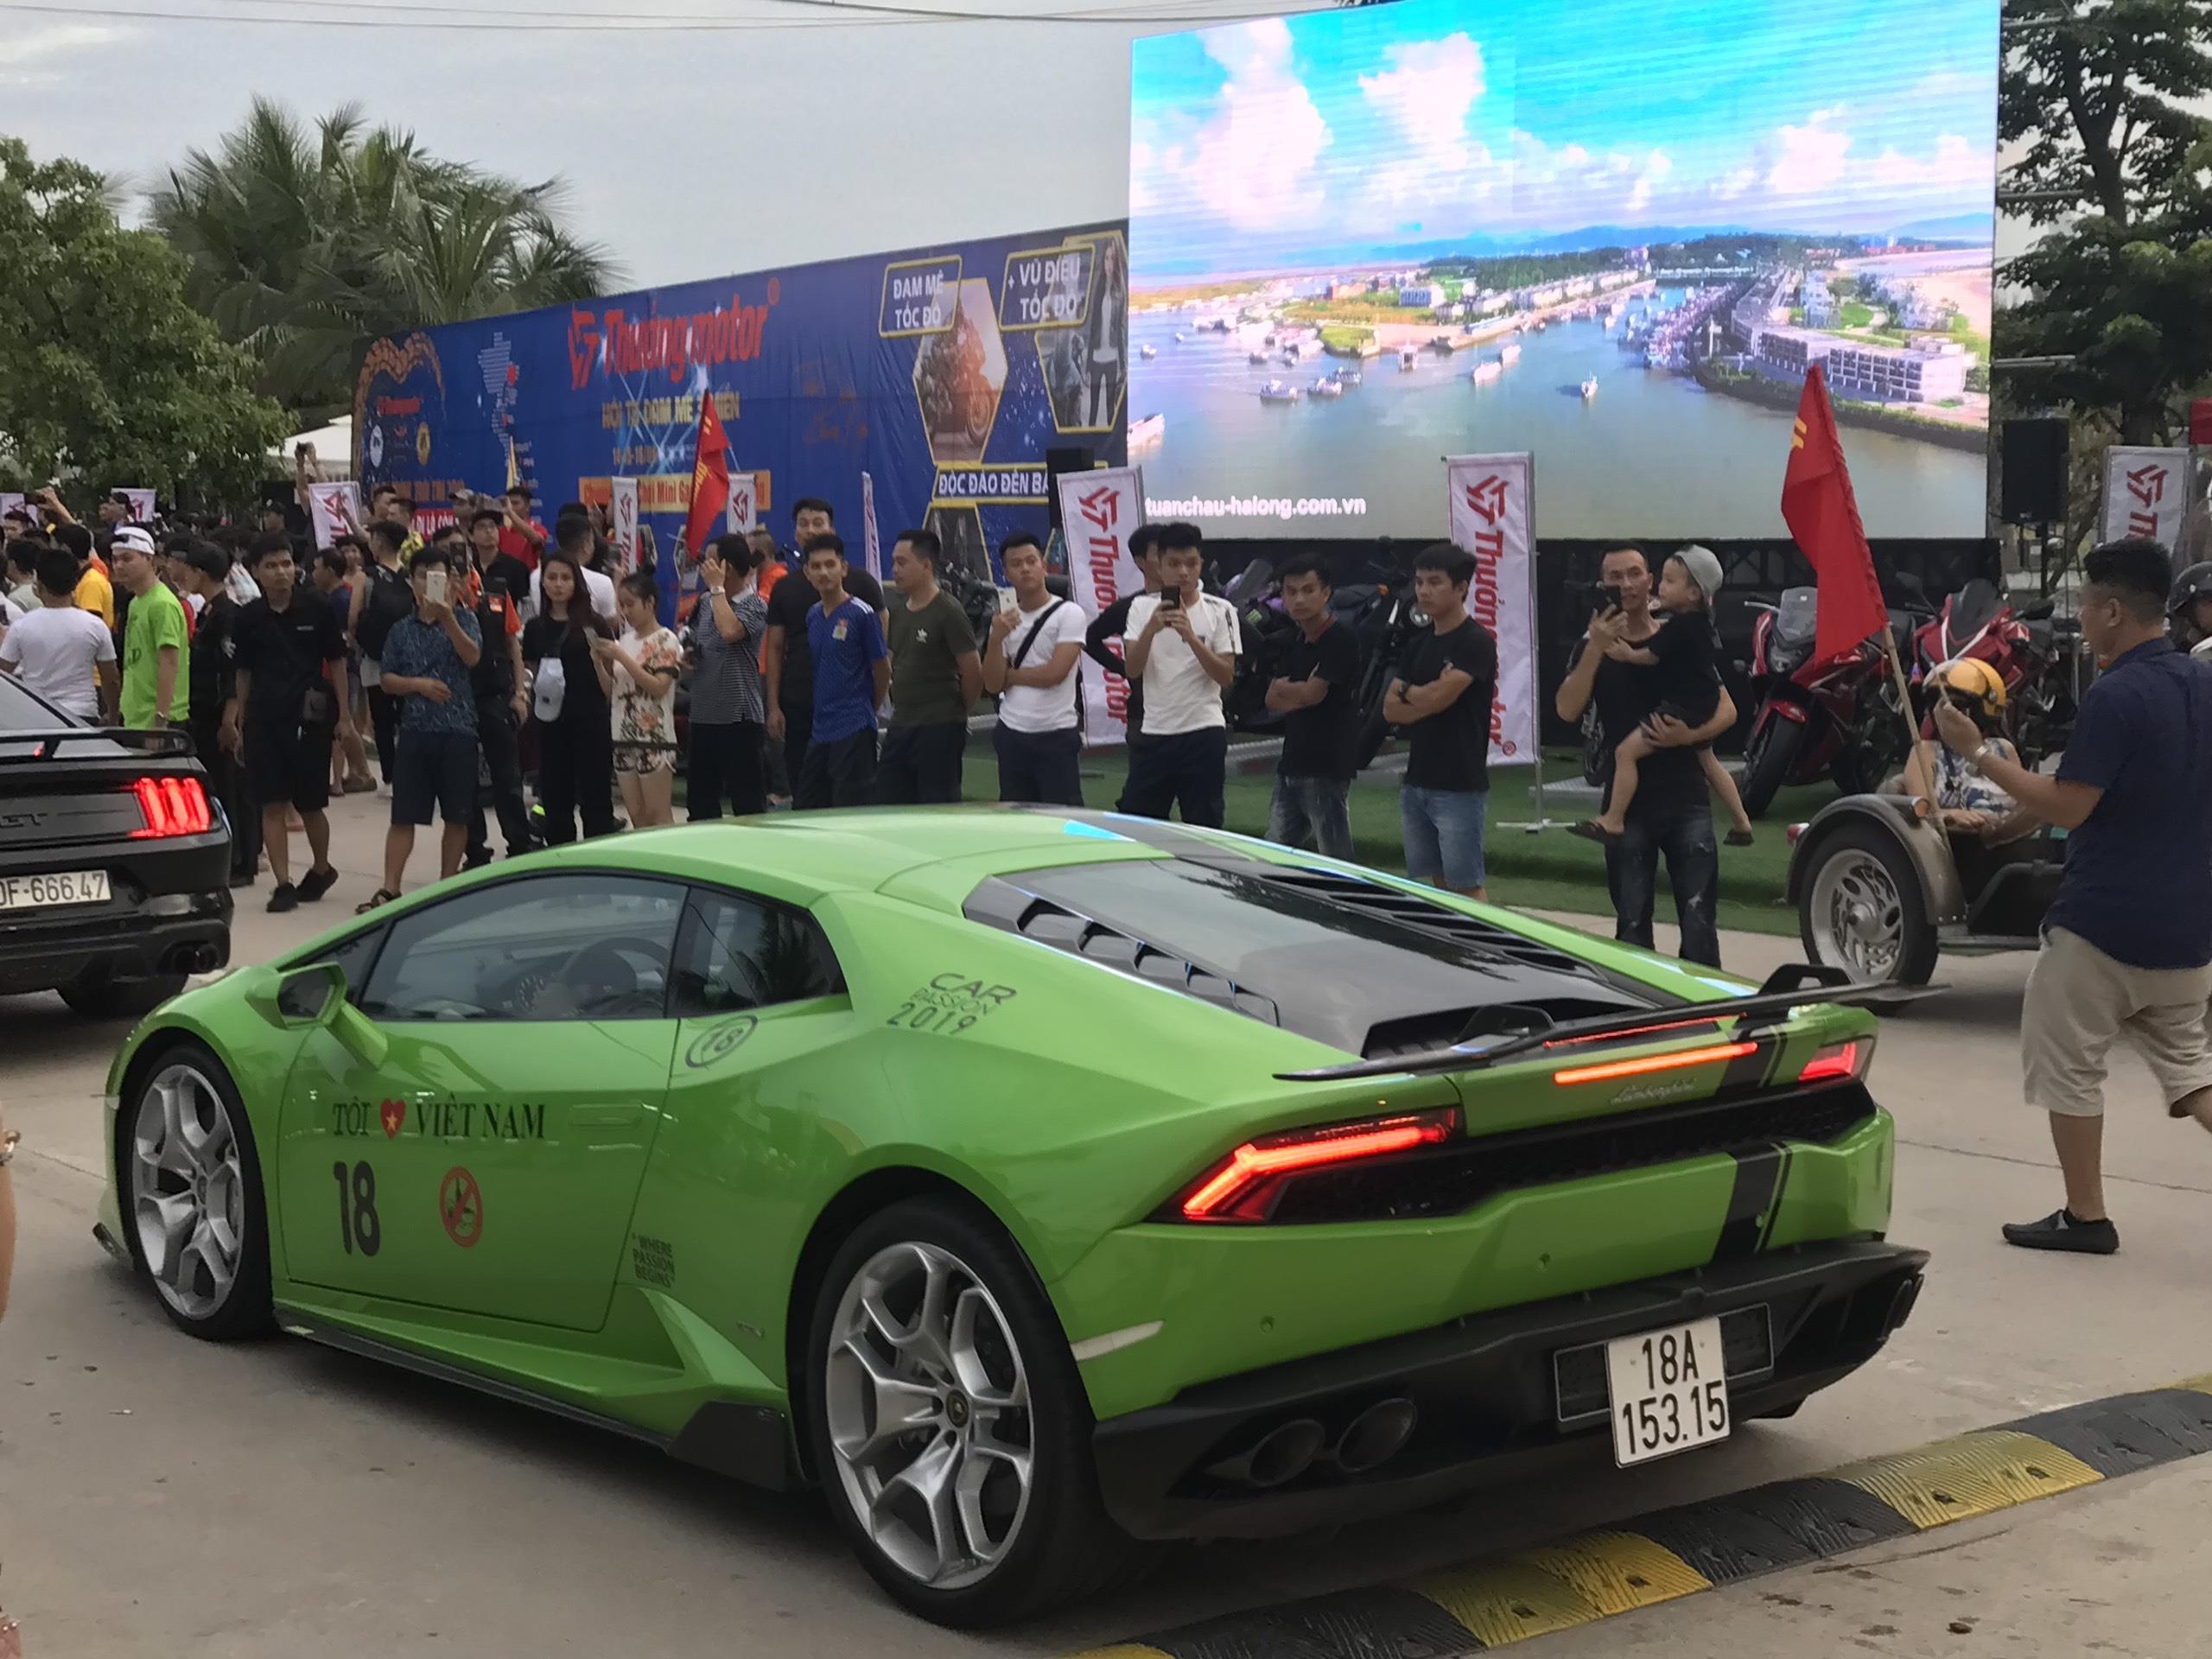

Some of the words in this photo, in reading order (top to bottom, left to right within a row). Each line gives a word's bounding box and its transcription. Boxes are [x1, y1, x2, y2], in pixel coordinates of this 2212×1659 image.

[1145, 495, 1366, 519] tuanchau-halong.com.vn
[930, 972, 1017, 1005] CAR
[887, 1001, 978, 1035] 2019
[332, 1096, 372, 1137] TÔI
[416, 1092, 477, 1145] VIỆT
[484, 1103, 546, 1140] NAM
[334, 1160, 381, 1257] 18
[1642, 1329, 1699, 1390] 18A
[1622, 1379, 1726, 1455] 153.15
